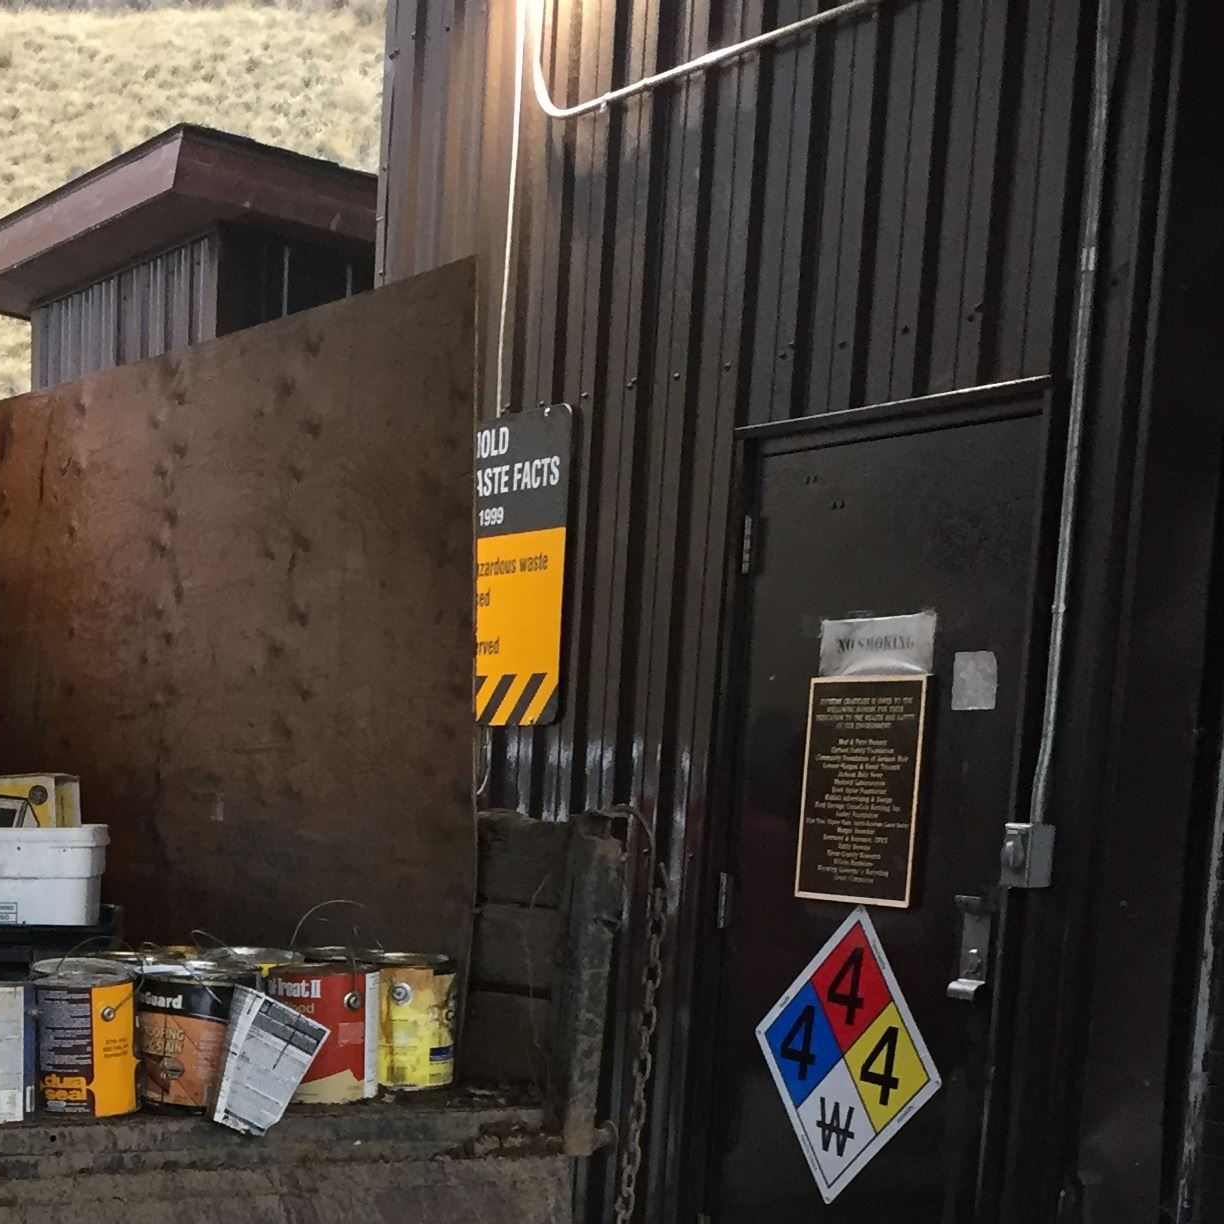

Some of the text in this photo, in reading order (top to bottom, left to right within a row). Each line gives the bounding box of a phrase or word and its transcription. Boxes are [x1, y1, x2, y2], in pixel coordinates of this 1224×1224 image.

[513, 456, 560, 492] FACTS
[479, 506, 504, 526] 1999
[520, 552, 548, 572] waste
[828, 947, 864, 1026] 4
[780, 1004, 816, 1081] 4
[860, 1026, 900, 1106] 4
[44, 1088, 87, 1100] seal
[816, 1096, 854, 1158] W
